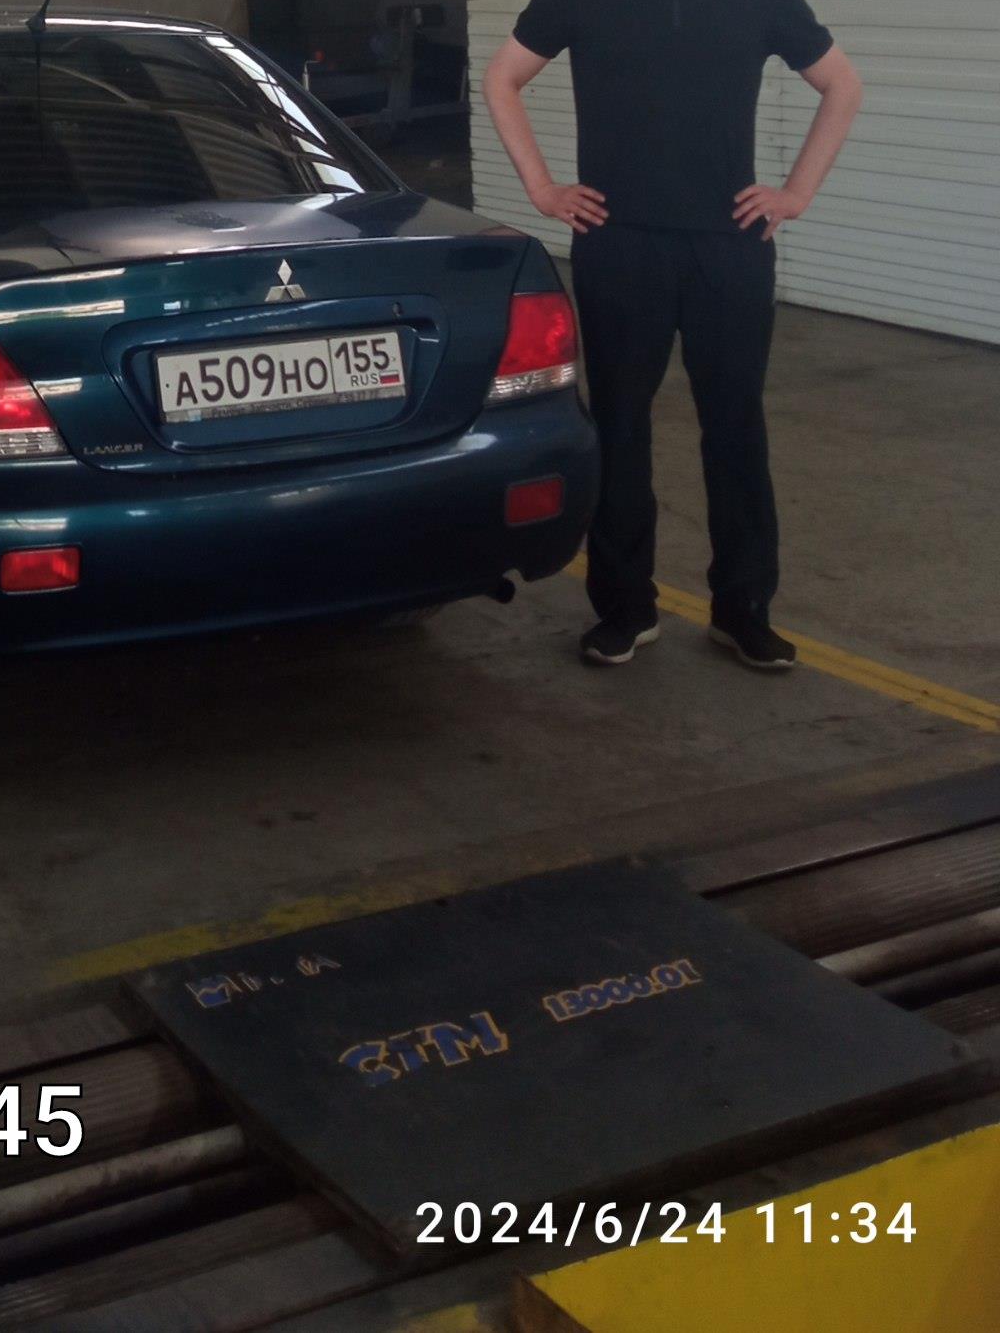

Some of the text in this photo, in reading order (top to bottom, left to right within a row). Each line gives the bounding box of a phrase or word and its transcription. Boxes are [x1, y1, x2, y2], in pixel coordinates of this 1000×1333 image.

[175, 353, 328, 407] А509НО
[334, 338, 390, 374] 155
[350, 373, 379, 387] RUS
